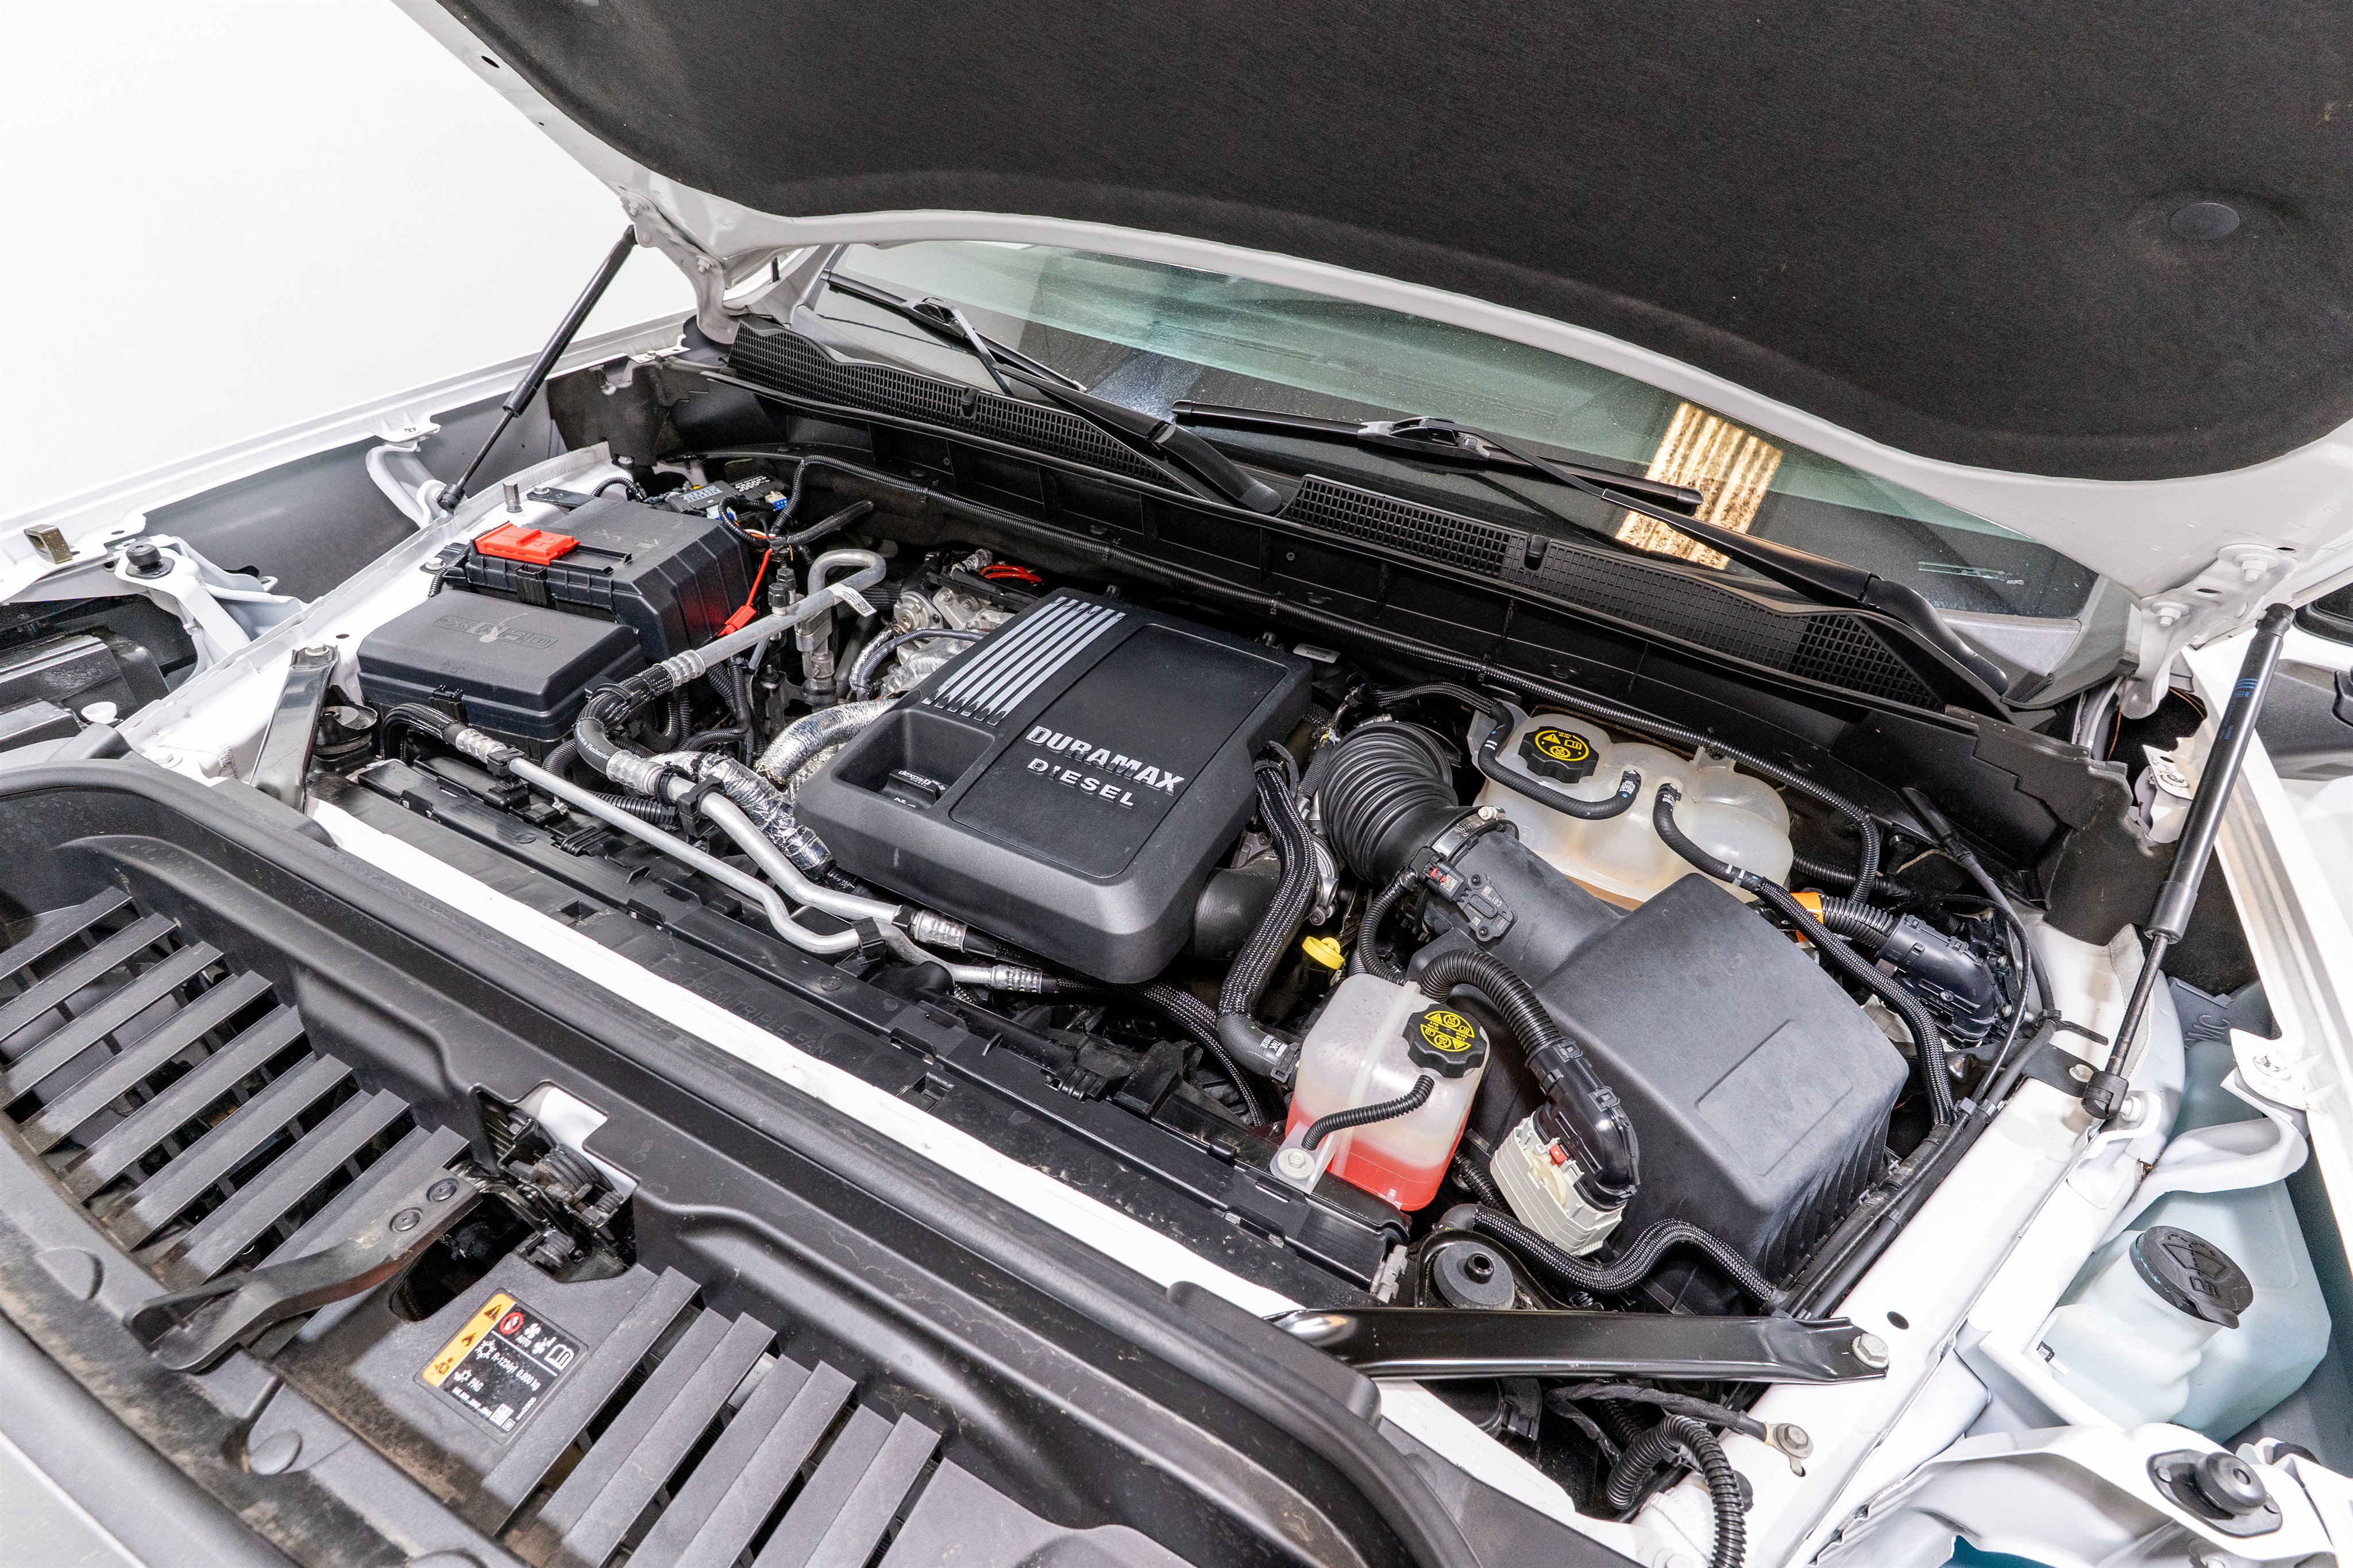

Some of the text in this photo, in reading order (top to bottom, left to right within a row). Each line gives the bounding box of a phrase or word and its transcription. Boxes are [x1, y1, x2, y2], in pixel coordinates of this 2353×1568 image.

[586, 743, 611, 760] Flexbarrier
[1024, 725, 1185, 796] DURAMAX
[1027, 758, 1134, 809] DIESEL
[1492, 897, 1502, 907] C01
[1269, 1040, 1282, 1052] TNK
[515, 1334, 532, 1347] AUTO
[491, 1352, 541, 1391] R-1234yf 0.600 kg
[467, 1377, 484, 1392] PAG
